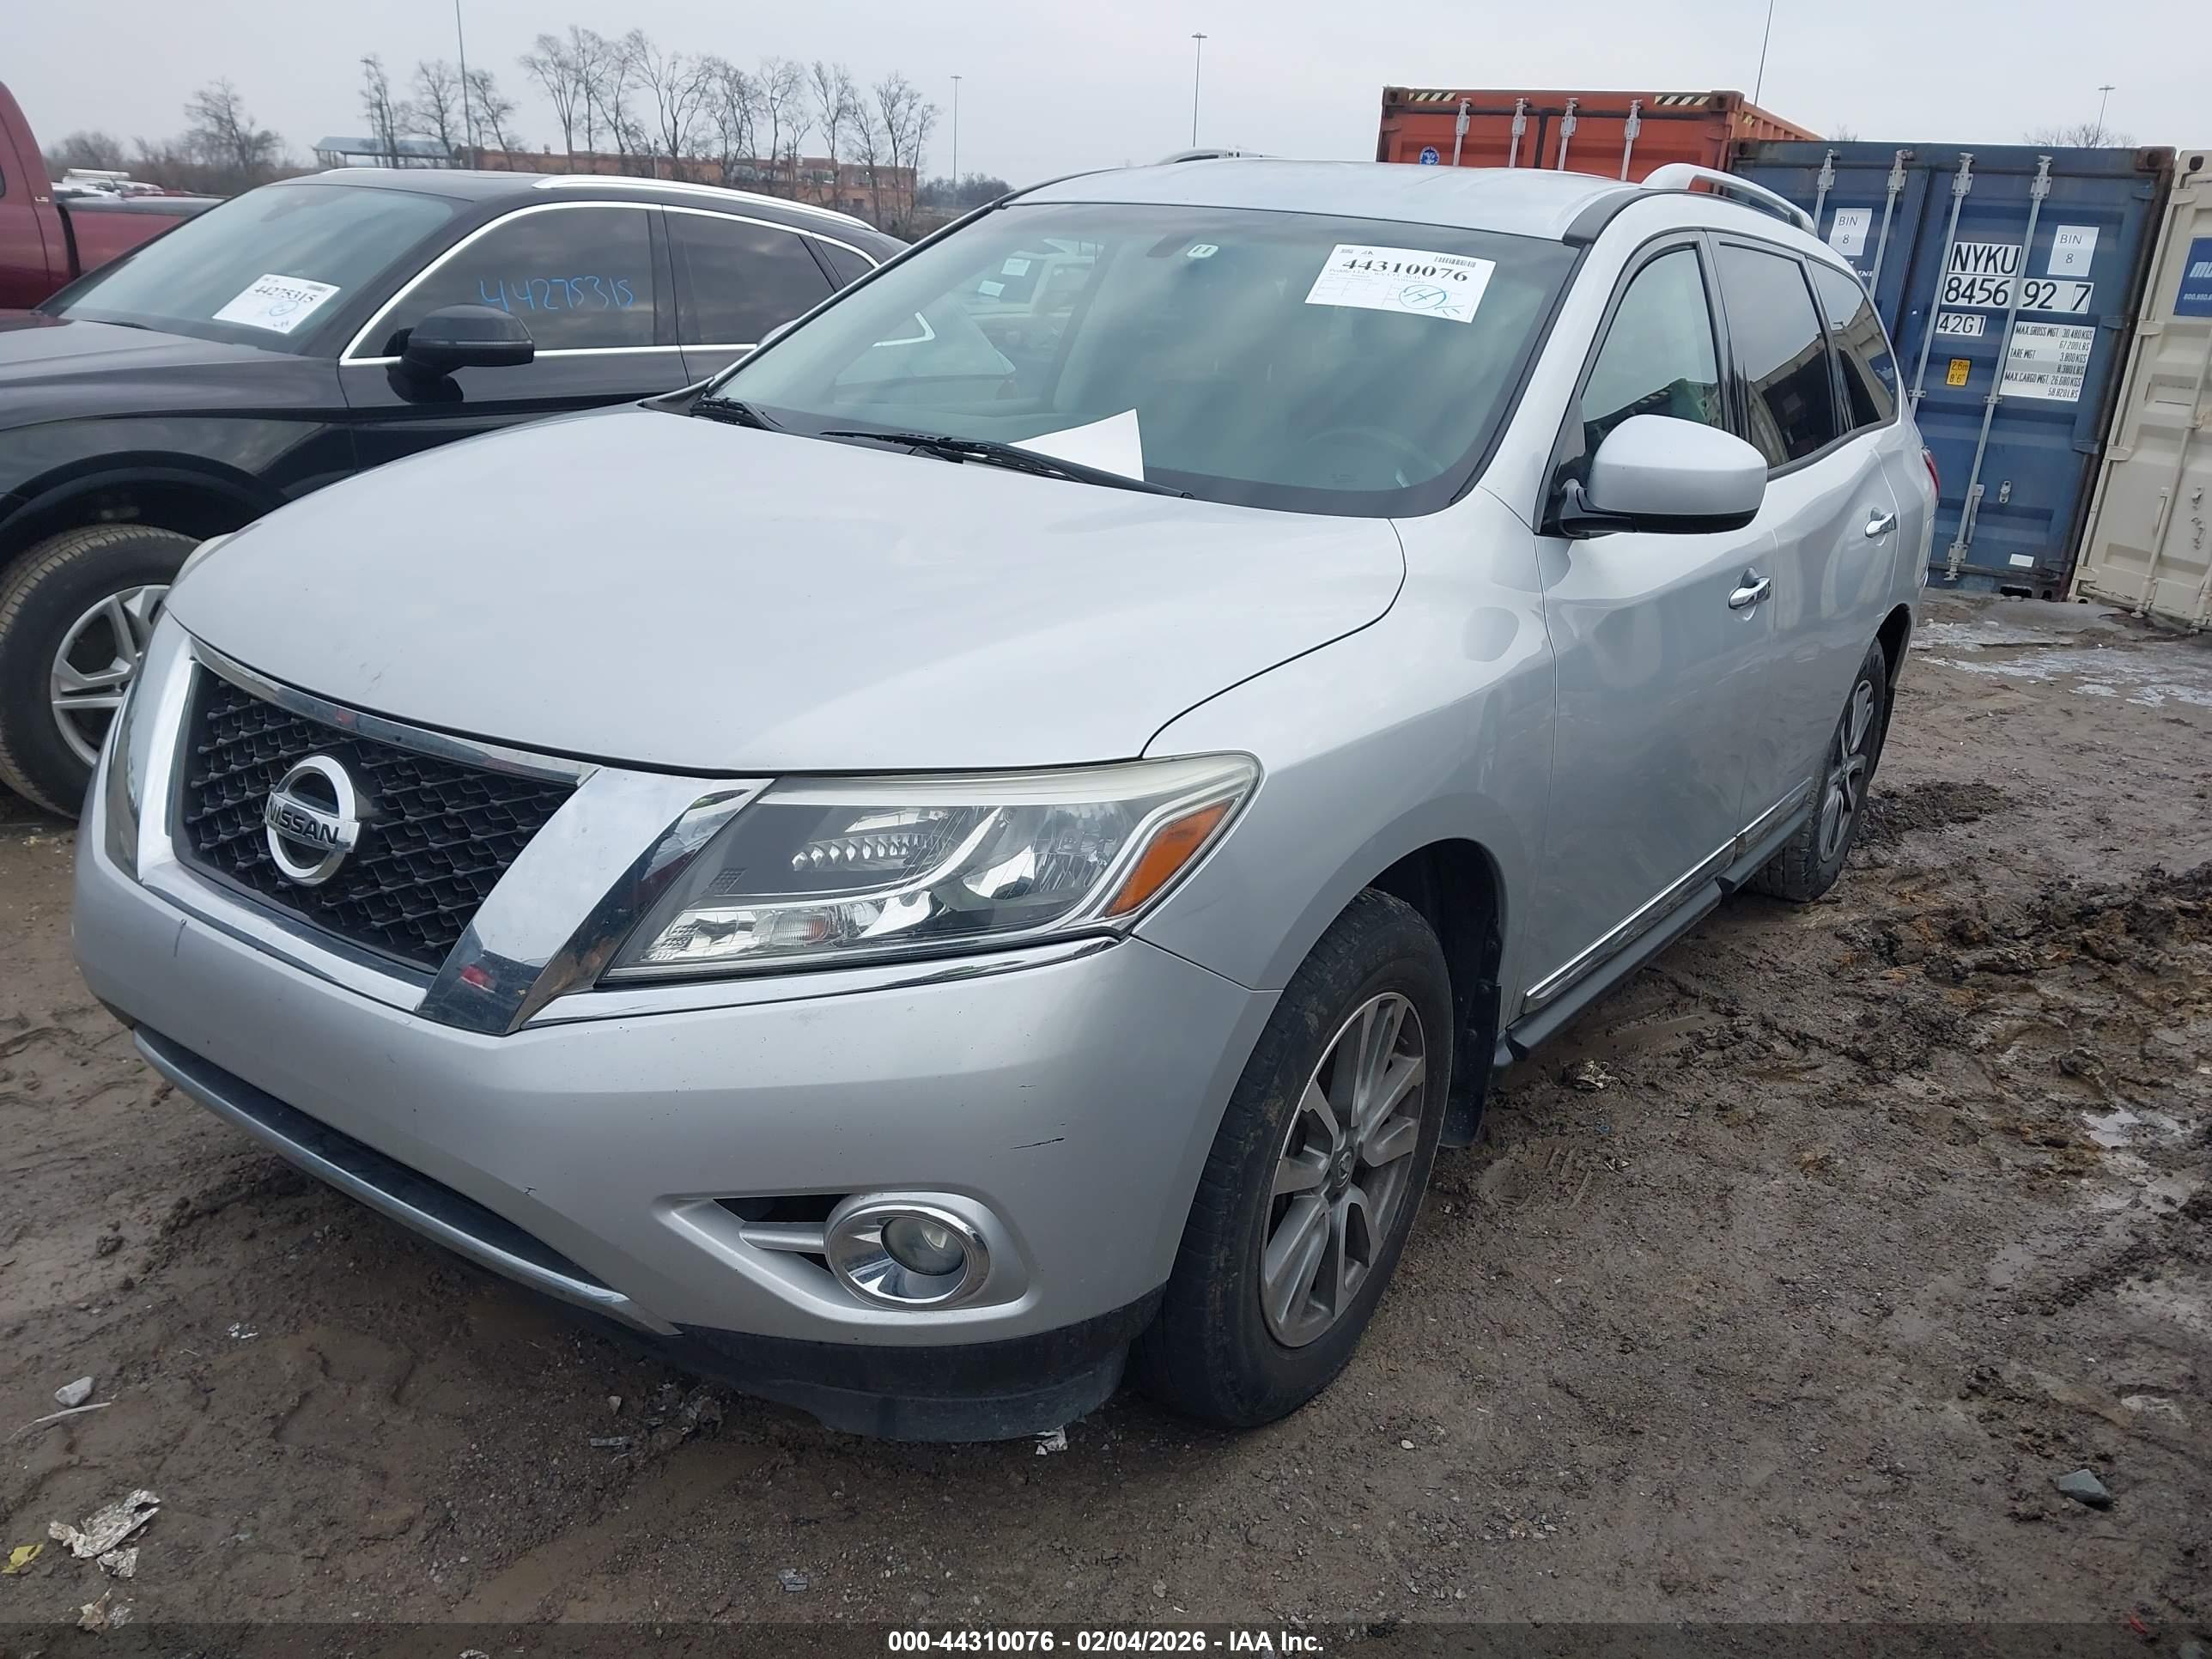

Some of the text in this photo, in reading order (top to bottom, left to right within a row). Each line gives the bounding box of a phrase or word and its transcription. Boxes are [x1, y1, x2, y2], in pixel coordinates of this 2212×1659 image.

[1838, 216, 1858, 226] BIN
[1842, 234, 1850, 244] 8
[2060, 234, 2082, 244] BIN
[1951, 244, 2021, 274] NYKU
[2066, 252, 2074, 263] 8
[1342, 258, 1471, 282] 44310076
[480, 276, 633, 312] 44275315
[2071, 284, 2092, 312] 7
[1939, 314, 1984, 335] 42G1
[268, 800, 339, 844] NISSAN
